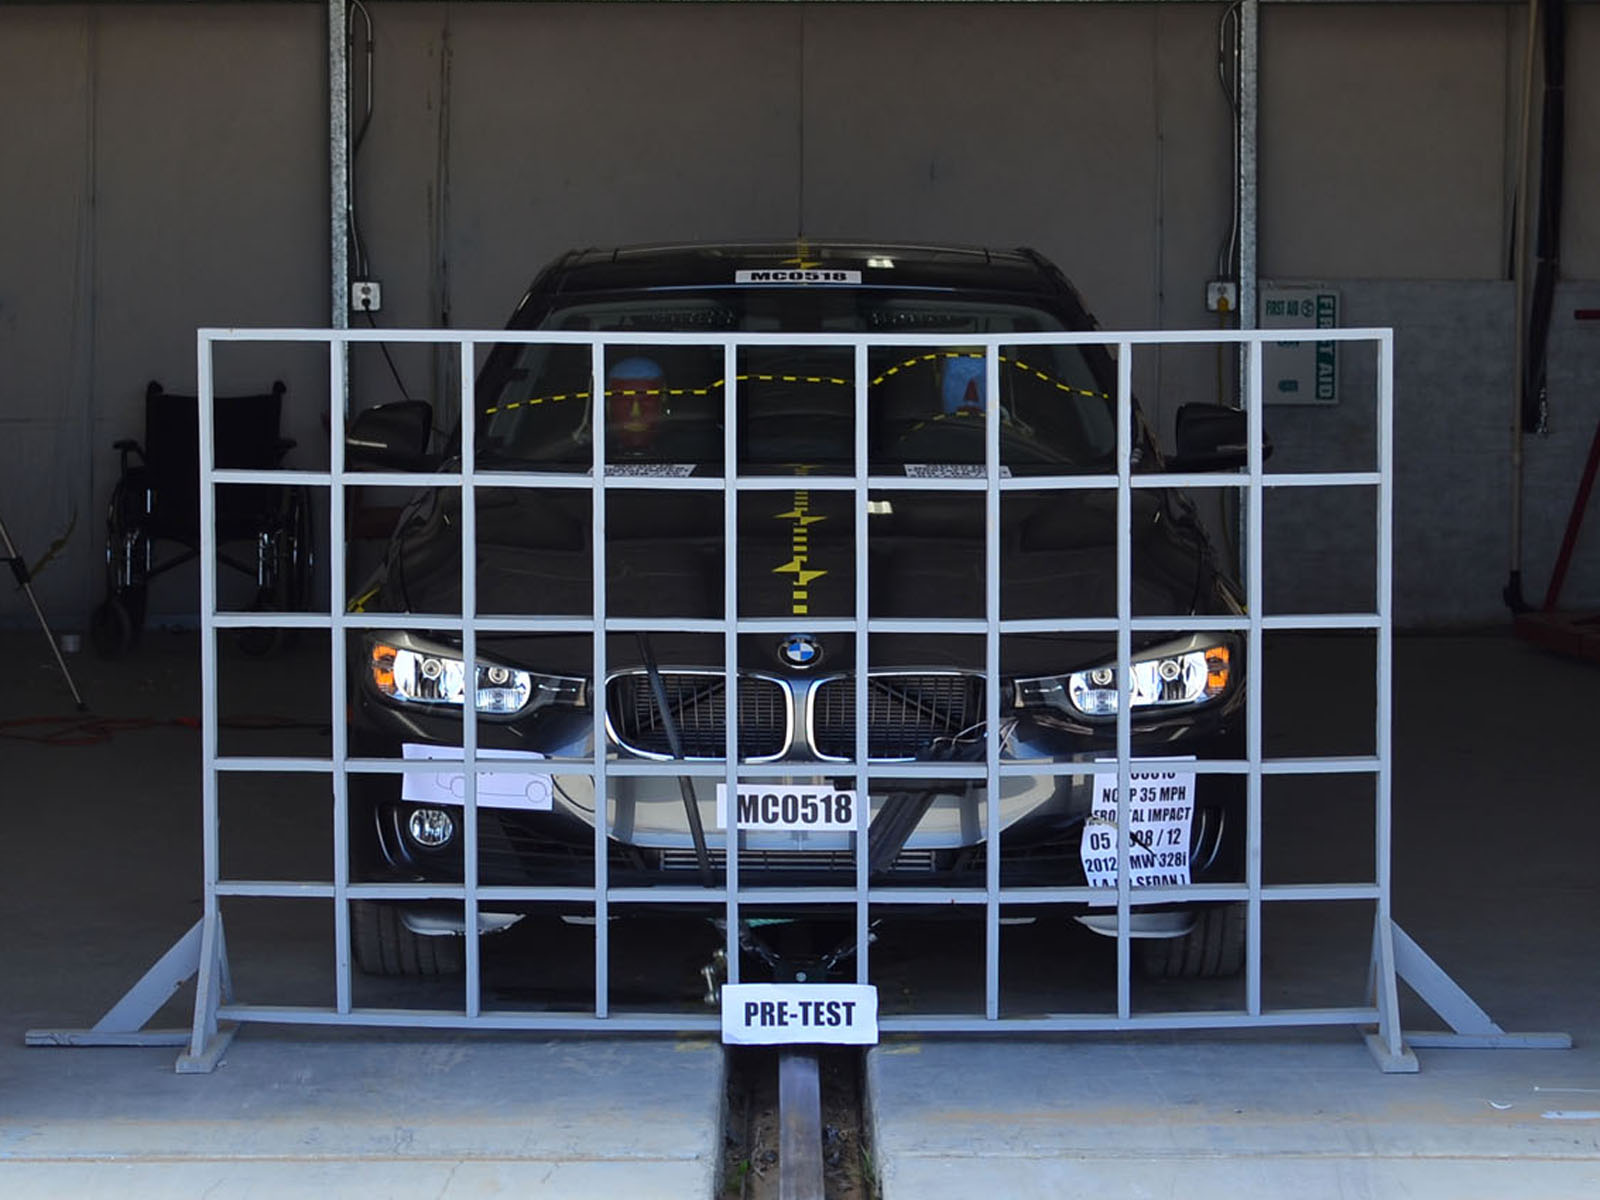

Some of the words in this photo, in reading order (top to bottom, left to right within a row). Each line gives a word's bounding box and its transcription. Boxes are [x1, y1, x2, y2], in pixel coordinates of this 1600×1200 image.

[1319, 297, 1332, 354] FIRT
[1319, 363, 1332, 398] AID
[1140, 787, 1156, 802] 35
[1160, 786, 1186, 801] MPH
[1148, 807, 1191, 822] IMPACT
[1090, 832, 1111, 851] 05
[1167, 828, 1181, 845] 12
[1085, 857, 1118, 873] 2012
[1129, 854, 1156, 870] MW
[1159, 852, 1186, 867] 328i
[744, 1001, 856, 1027] PRE-TEST
